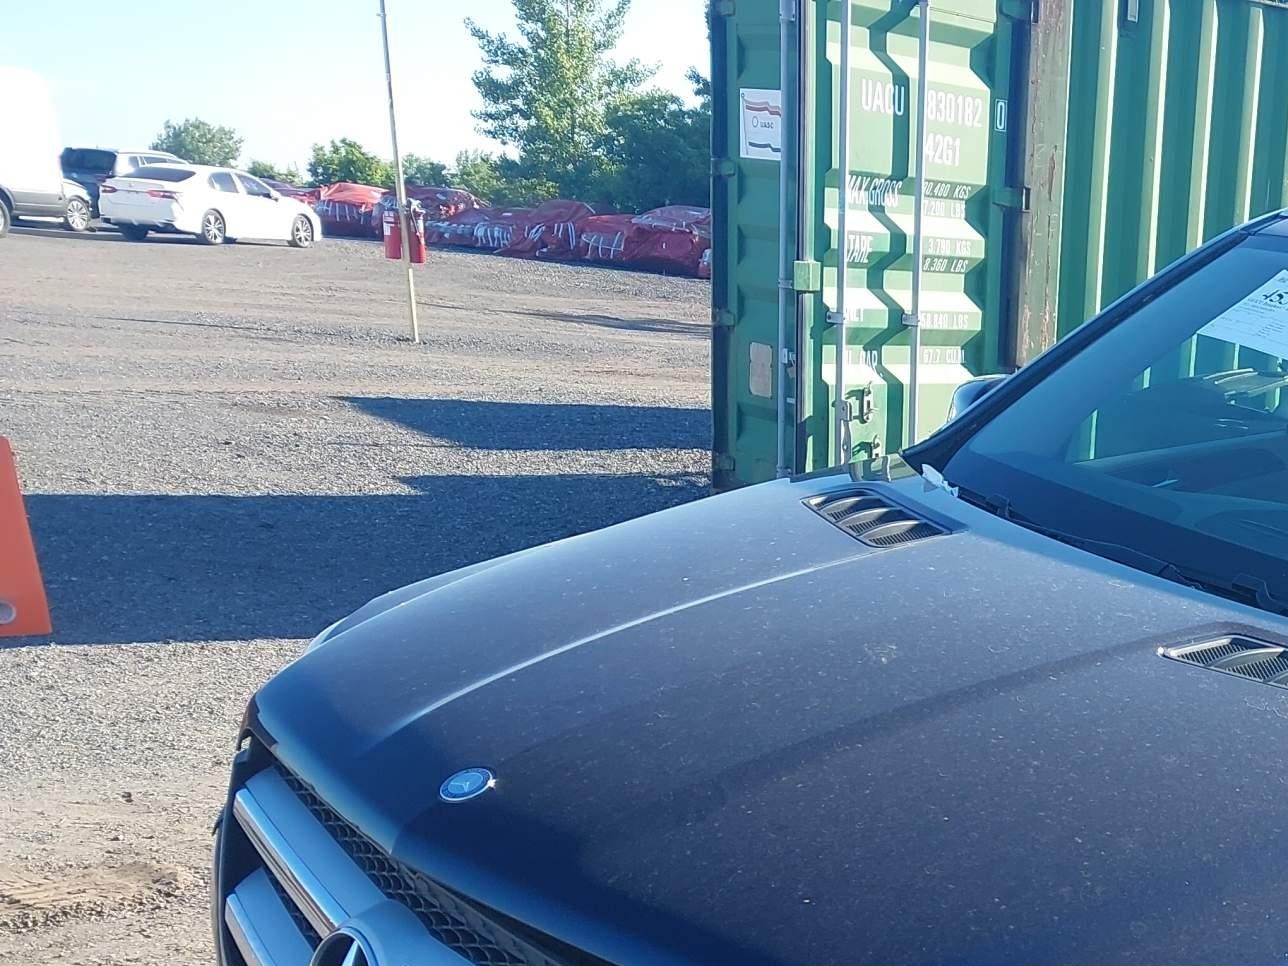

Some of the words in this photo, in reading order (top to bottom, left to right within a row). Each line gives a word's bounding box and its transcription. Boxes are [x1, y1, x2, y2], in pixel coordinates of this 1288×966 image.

[861, 78, 905, 116] UACU
[927, 89, 983, 128] 830182
[868, 177, 903, 208] GROSS
[953, 184, 971, 199] KGS
[847, 234, 873, 263] TARE
[955, 241, 971, 256] KGS
[923, 258, 947, 271] 8.360
[951, 259, 968, 272] LBS
